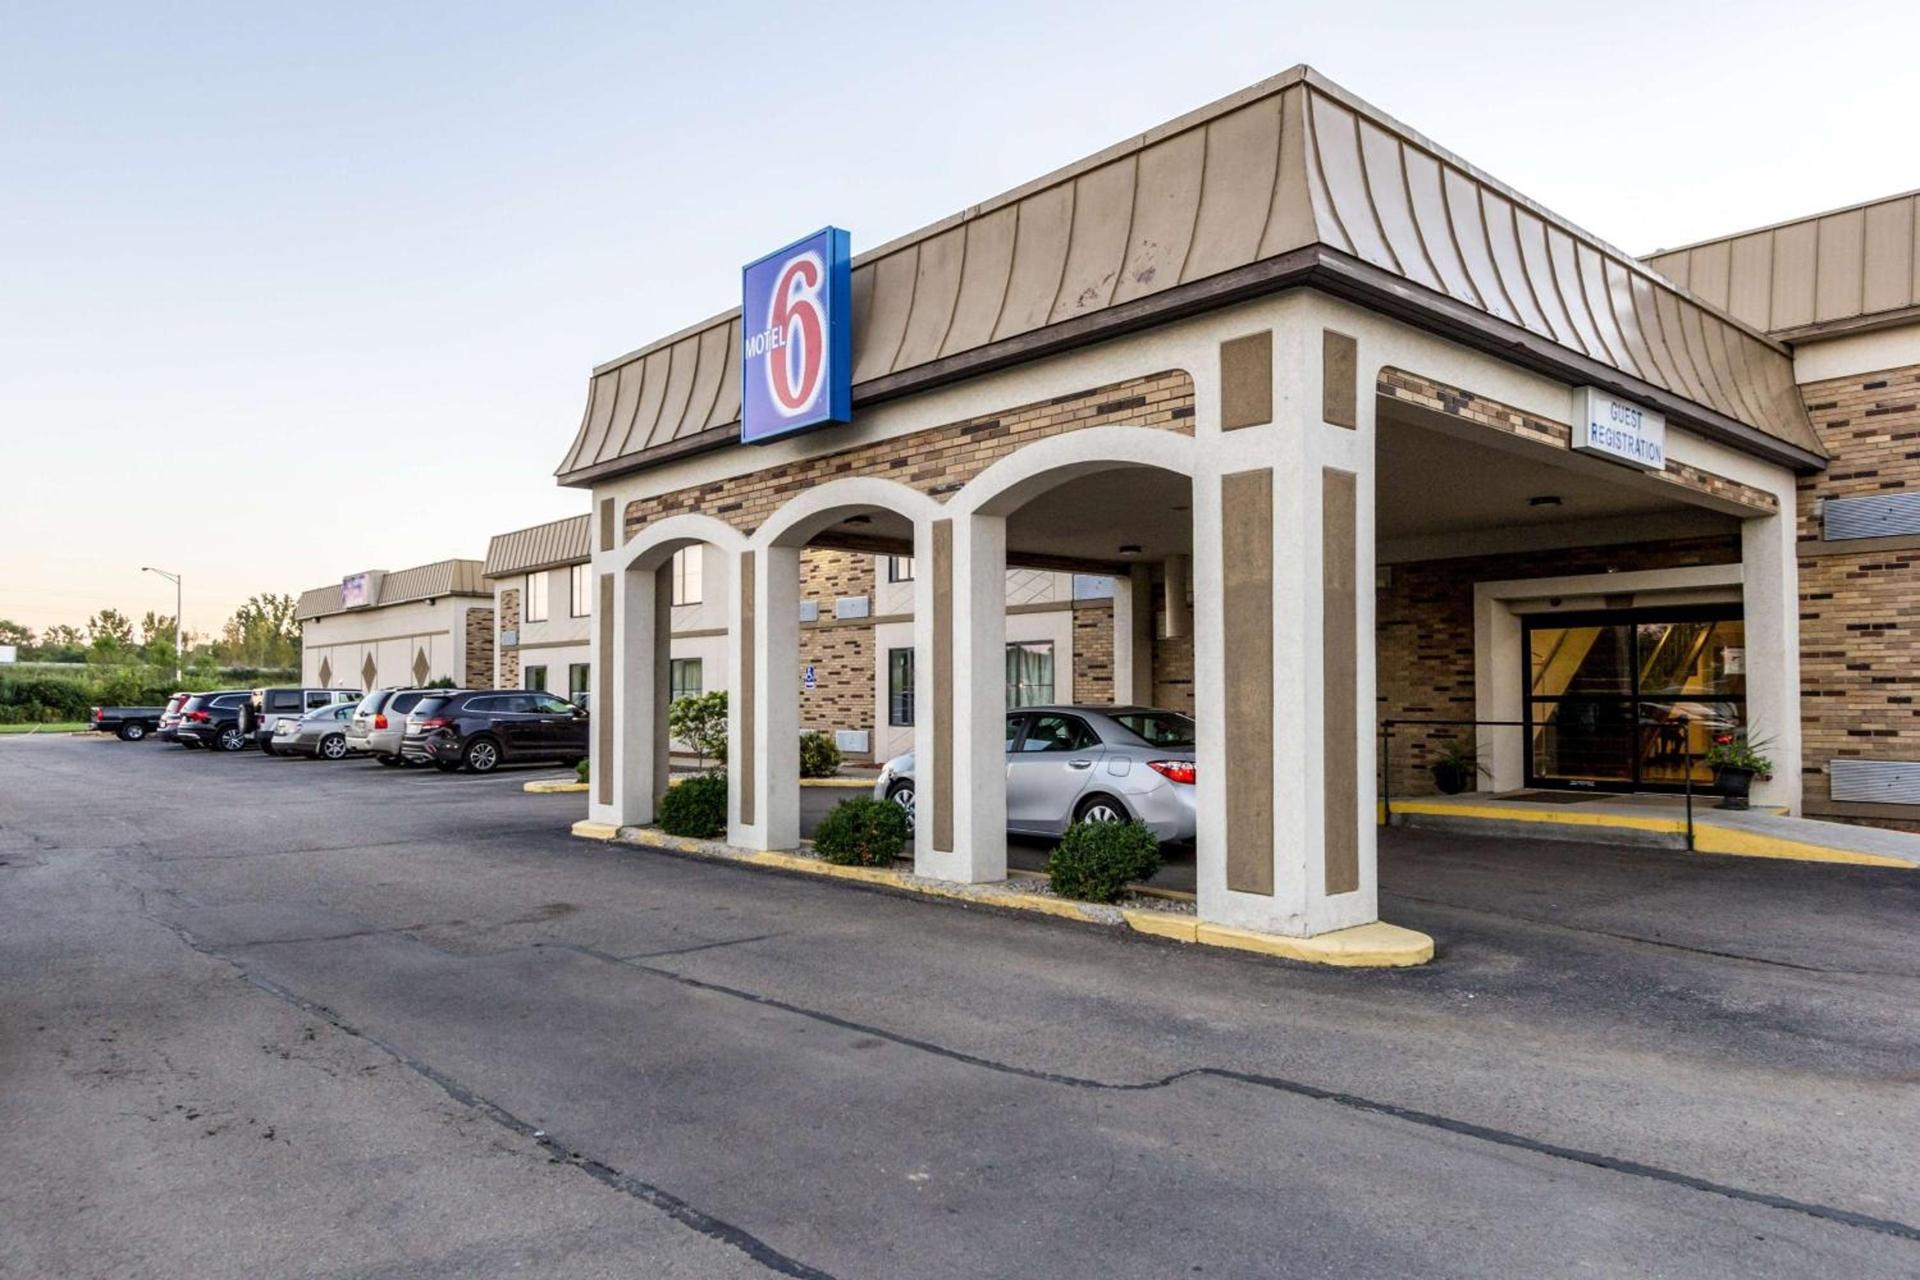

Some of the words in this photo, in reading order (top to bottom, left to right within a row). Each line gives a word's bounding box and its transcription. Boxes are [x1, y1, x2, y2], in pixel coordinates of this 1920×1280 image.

[745, 327, 786, 359] MOTEL
[770, 257, 823, 411] 6
[1610, 401, 1643, 430] GUEST
[1591, 422, 1662, 463] REGISTRATION
